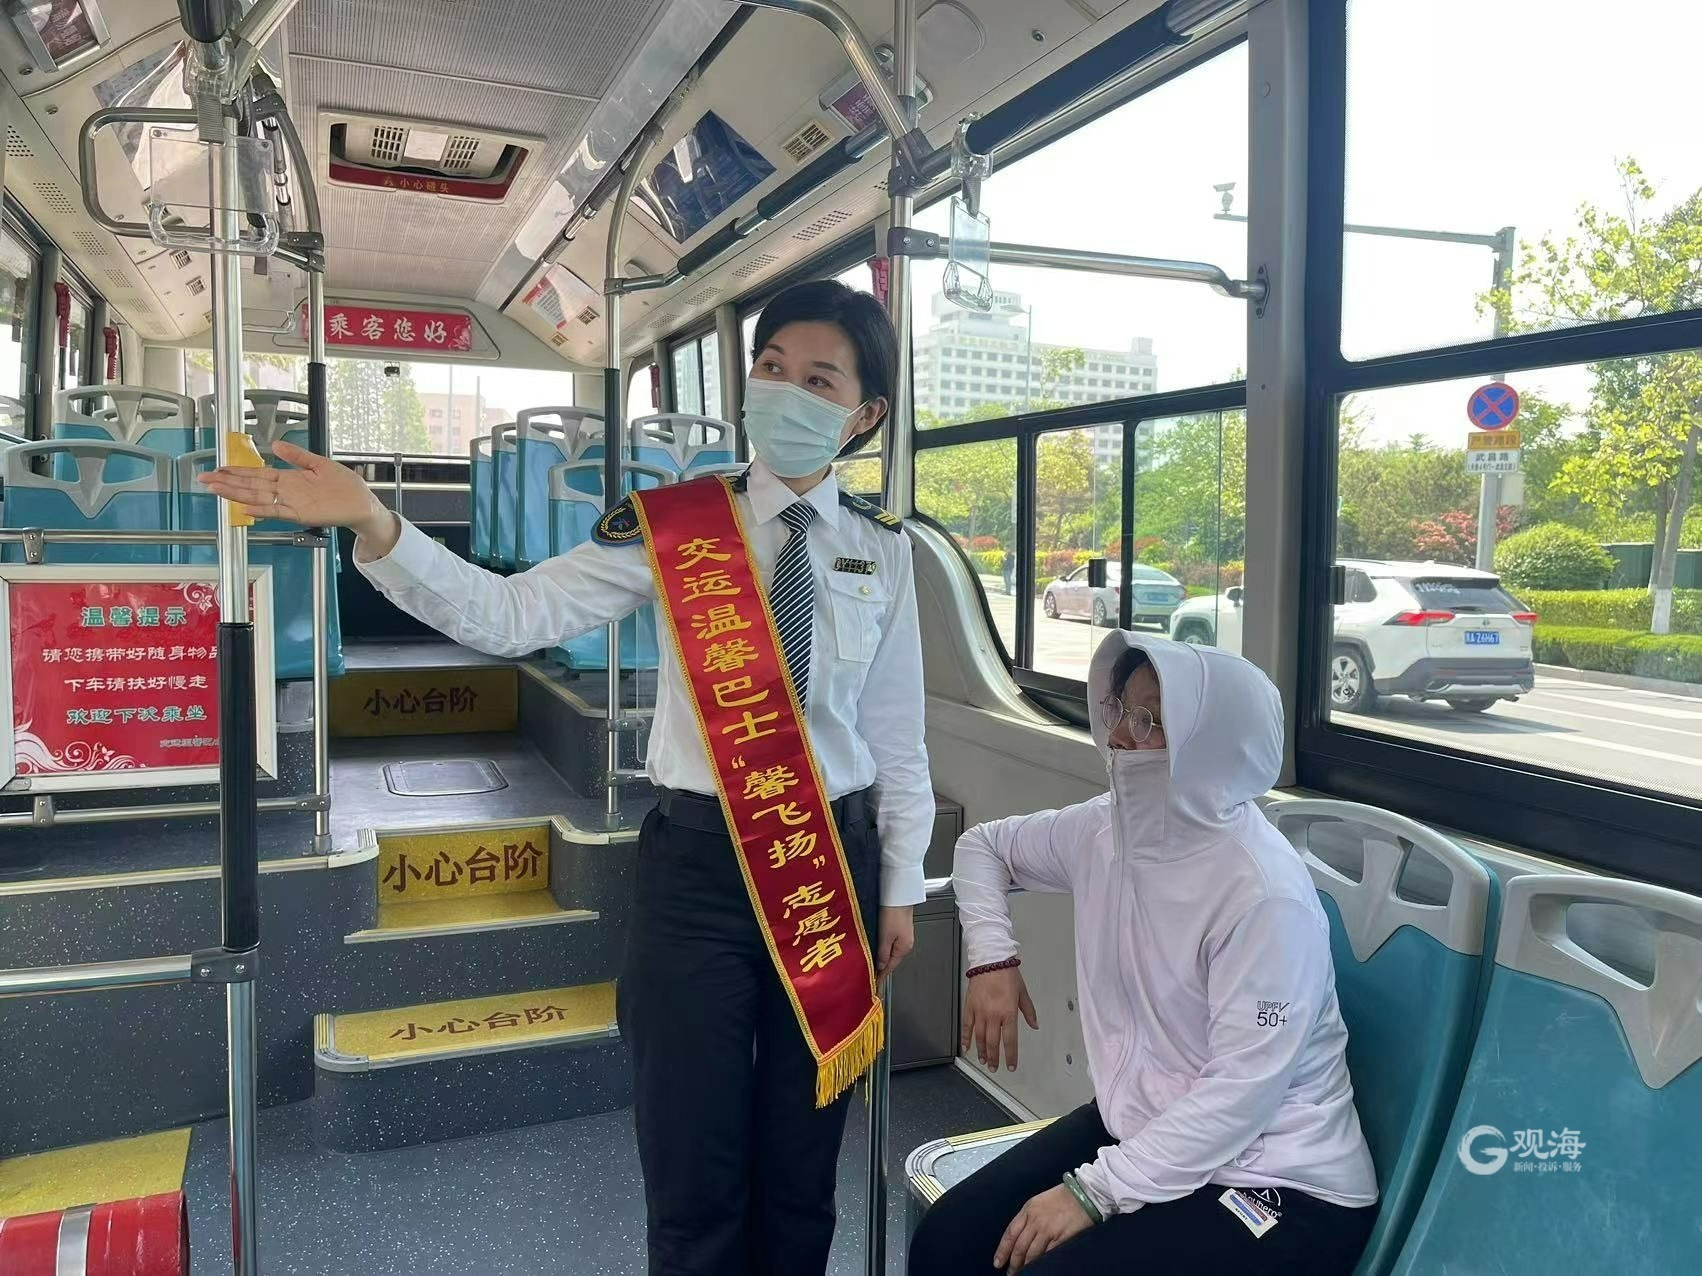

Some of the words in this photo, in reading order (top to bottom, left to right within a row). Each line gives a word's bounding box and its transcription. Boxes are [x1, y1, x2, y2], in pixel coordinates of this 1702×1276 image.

[328, 312, 448, 344] 乘客您好
[81, 606, 187, 627] 温馨提示
[64, 675, 208, 692] 下车请扶好慢走
[362, 685, 479, 716] 小心台阶
[66, 704, 207, 725] 欢迎下次乘坐
[382, 841, 543, 893] 小心台阶
[389, 1005, 569, 1041] 小心台阶
[1256, 1012, 1288, 1027] 50+
